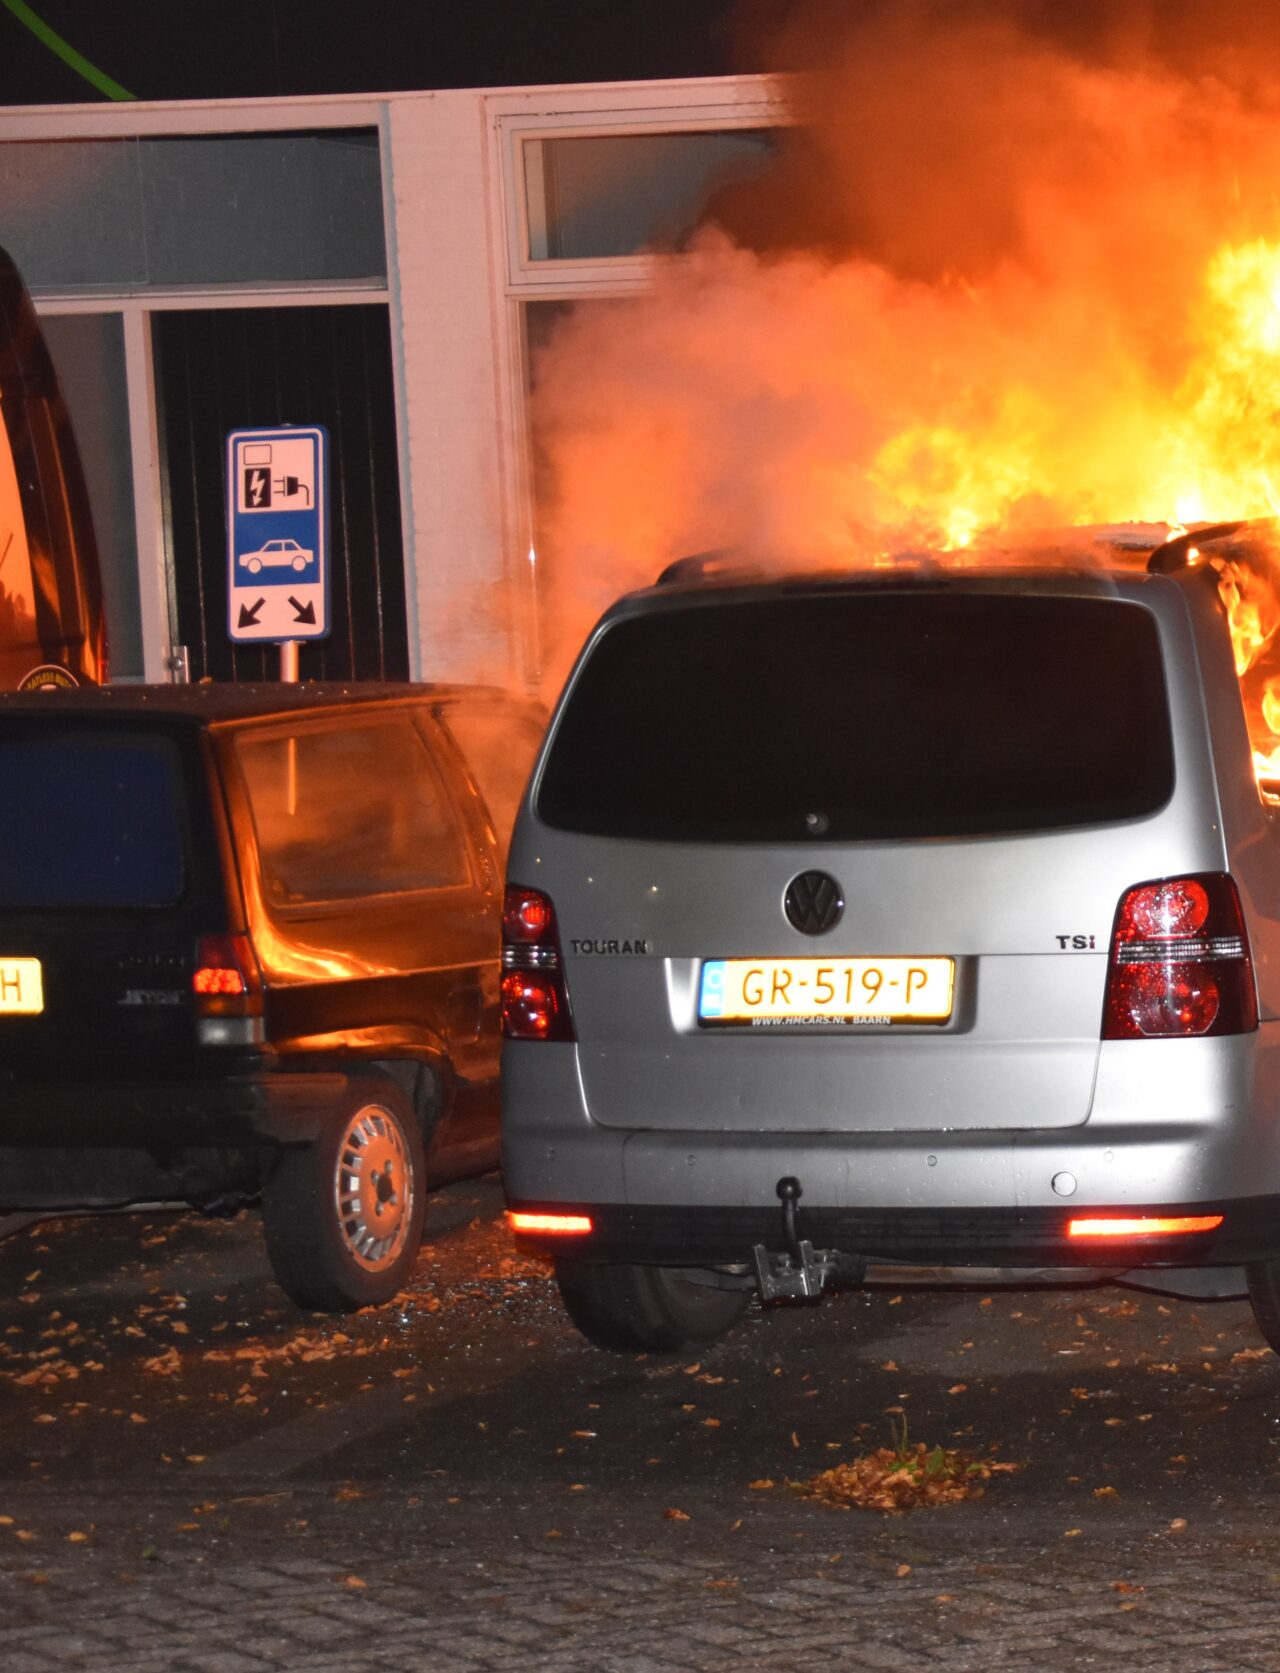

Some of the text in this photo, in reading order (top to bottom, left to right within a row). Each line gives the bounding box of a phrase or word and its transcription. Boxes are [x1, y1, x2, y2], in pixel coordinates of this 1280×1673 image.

[25, 671, 54, 689] EATLESS
[570, 939, 647, 954] TOURAN
[742, 967, 929, 1006] GR-519-P
[751, 1015, 891, 1026] WWW.HMCARS.NL BAARN
